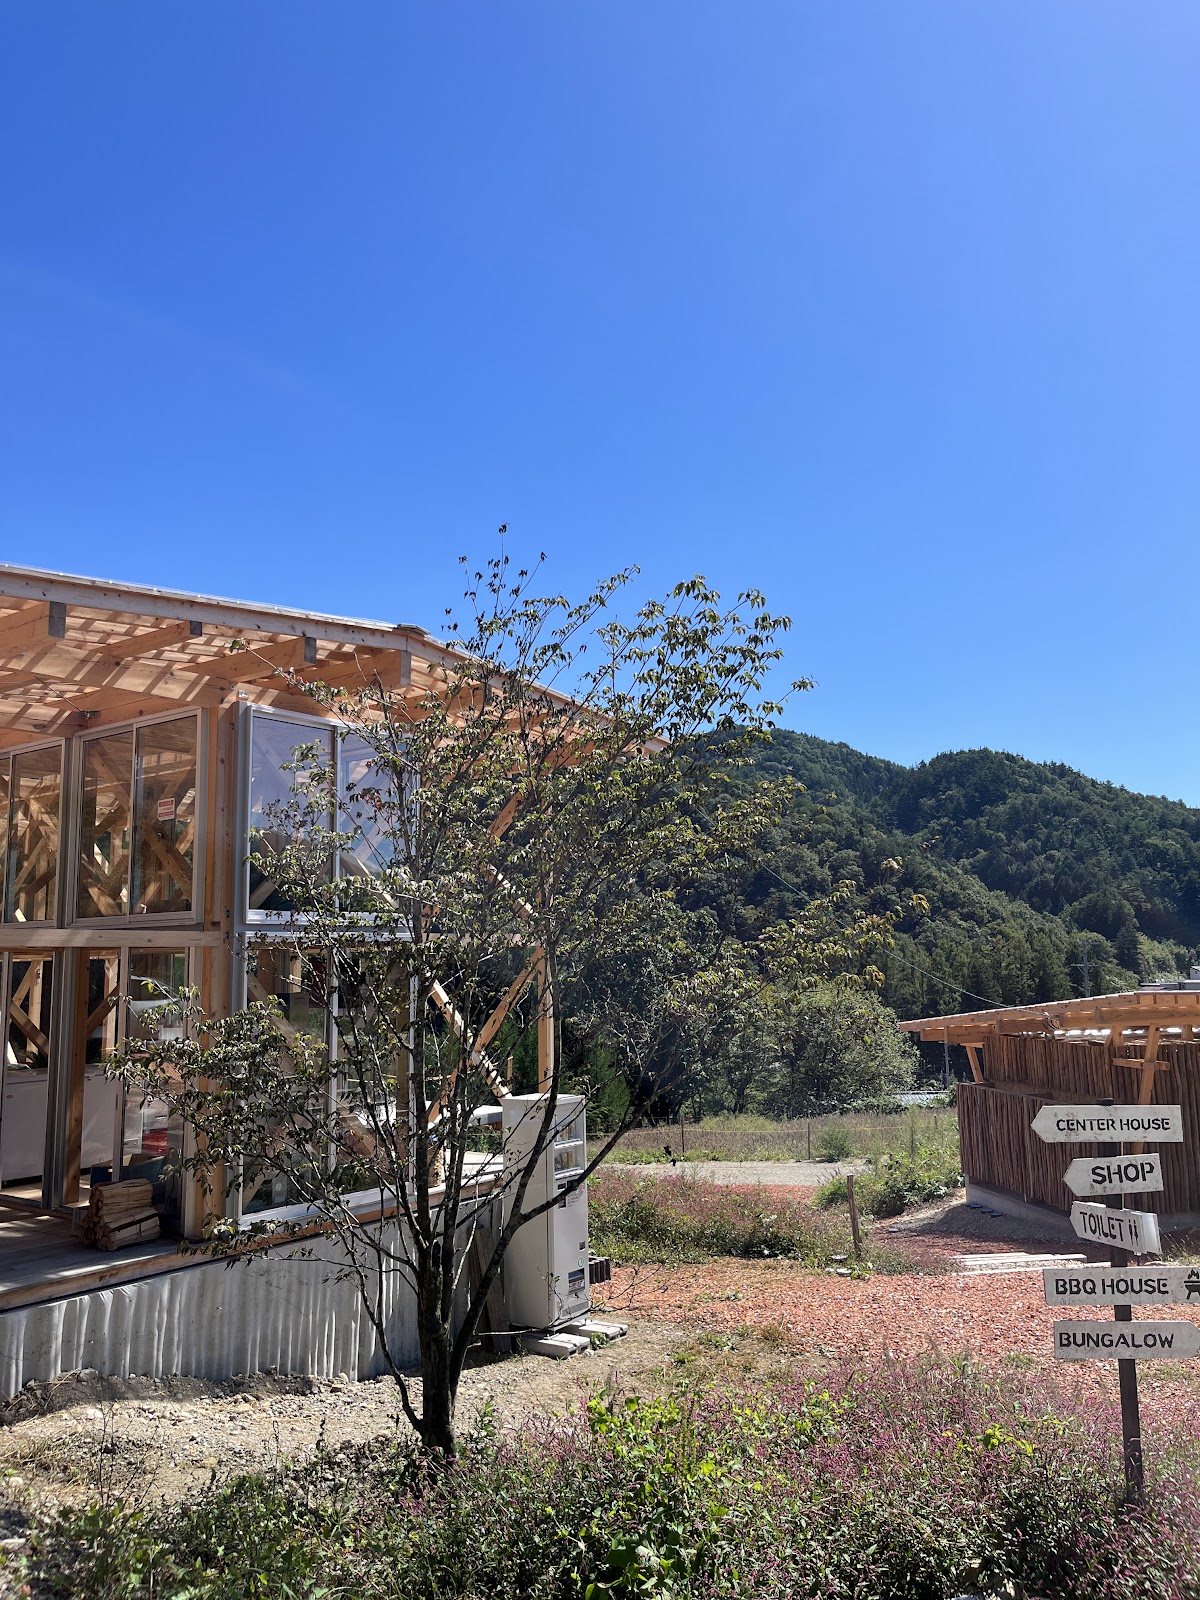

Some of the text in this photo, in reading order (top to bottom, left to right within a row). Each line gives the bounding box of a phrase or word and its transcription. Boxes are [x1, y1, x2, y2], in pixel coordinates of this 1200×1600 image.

[1055, 1117, 1171, 1132] CENTER HOUSE
[1091, 1162, 1155, 1185] SHOP
[1079, 1211, 1124, 1242] TOILET
[1055, 1278, 1169, 1295] BBQ HOUSE
[1058, 1332, 1174, 1349] BUNGALOW
